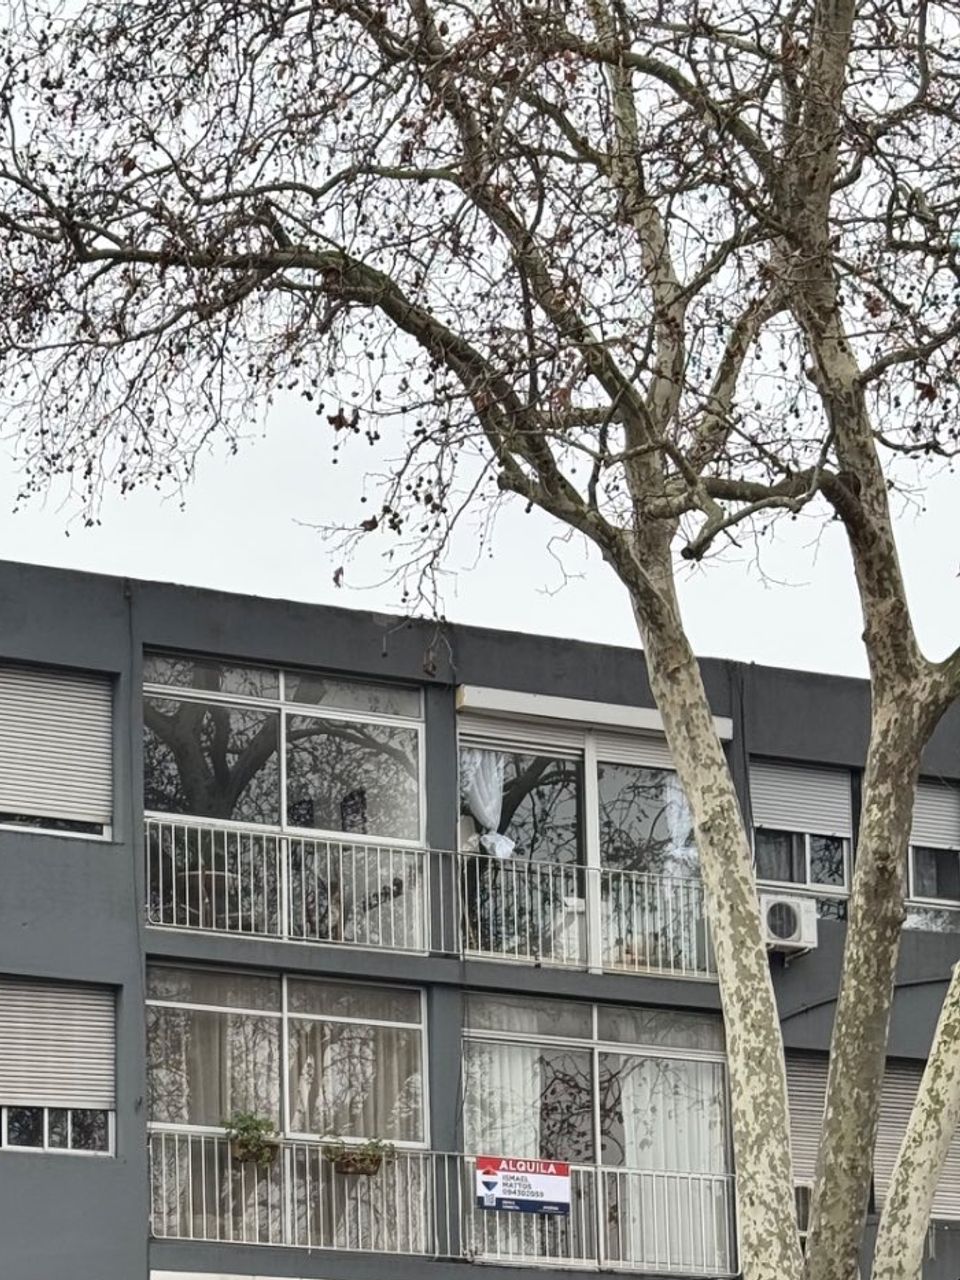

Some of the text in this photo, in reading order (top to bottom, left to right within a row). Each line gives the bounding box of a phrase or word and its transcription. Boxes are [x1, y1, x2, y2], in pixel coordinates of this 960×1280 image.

[500, 1160, 557, 1174] ALQUILA
[502, 1175, 528, 1183] ISMAEL
[502, 1182, 532, 1190] MATTOS
